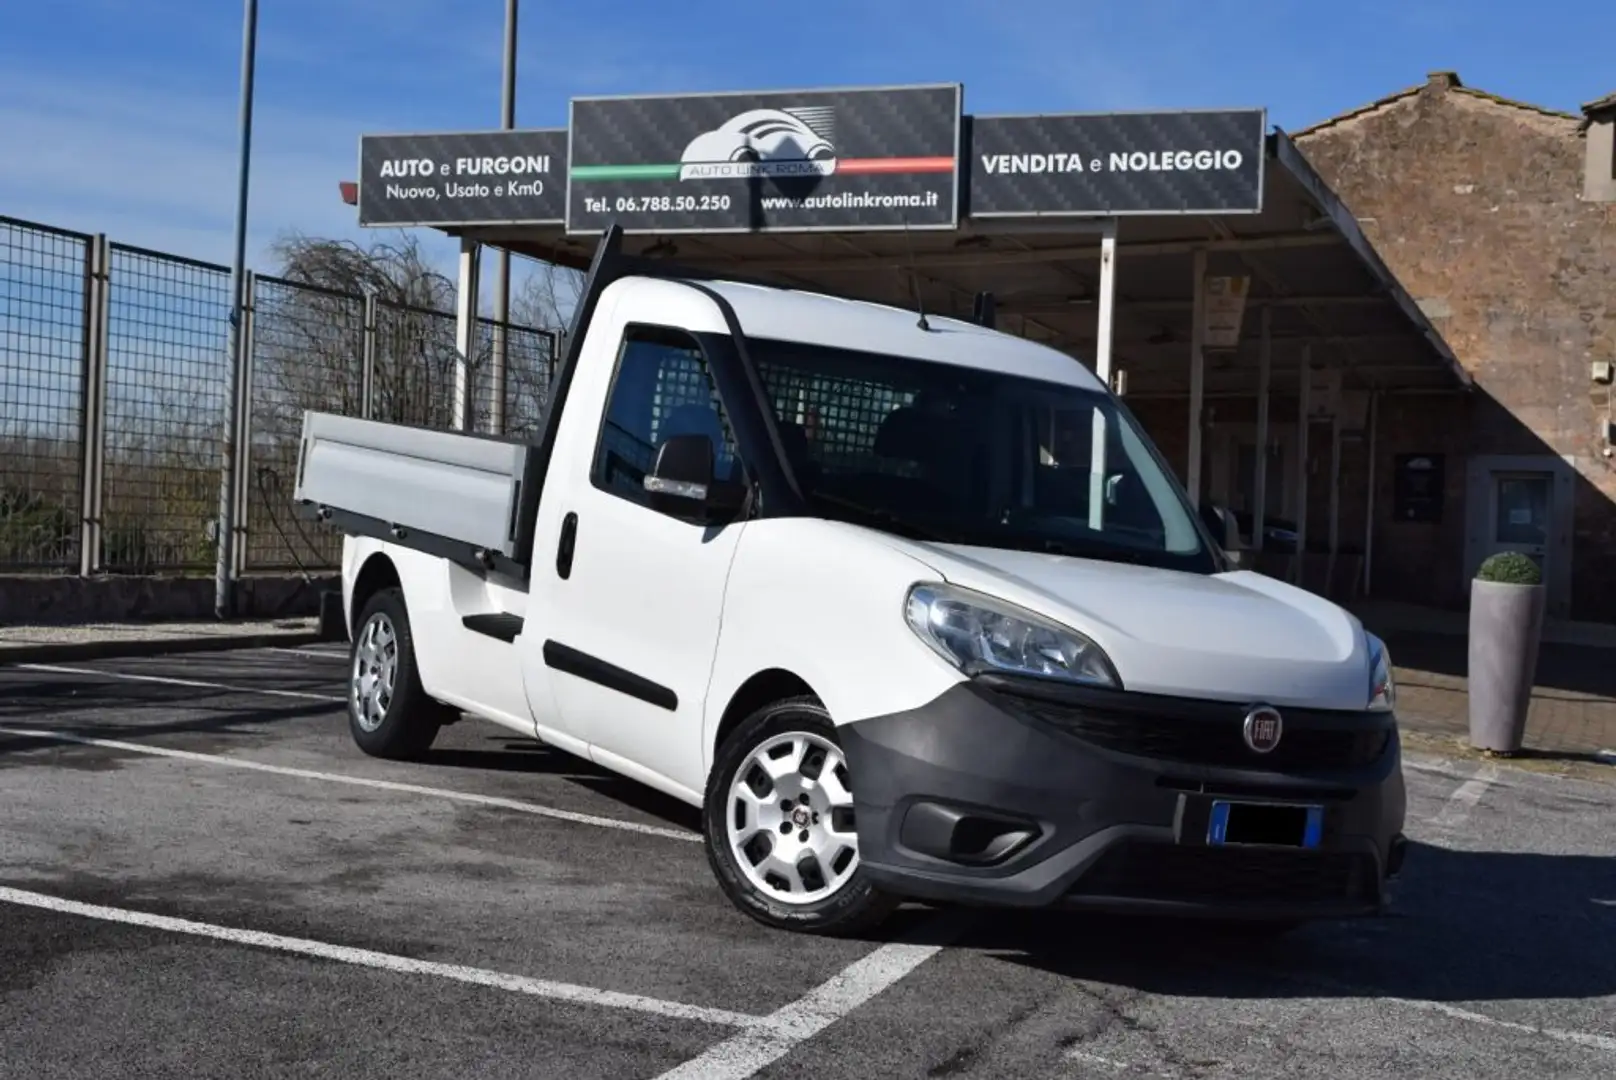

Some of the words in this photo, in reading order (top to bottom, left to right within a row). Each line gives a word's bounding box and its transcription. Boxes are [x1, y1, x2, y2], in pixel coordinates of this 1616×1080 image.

[380, 159, 434, 177] AUTO
[440, 163, 450, 176] e
[456, 155, 550, 175] FURGONI
[689, 165, 732, 176] AUTO
[736, 164, 770, 175] LINK
[776, 163, 825, 174] ROMA
[981, 153, 1084, 173] VENDITA
[1090, 158, 1102, 172] e
[1109, 150, 1243, 171] NOLEGGIO
[386, 183, 441, 200] Nuovo,
[445, 182, 490, 197] Usato
[494, 186, 503, 197] e
[507, 180, 543, 196] Km0
[760, 191, 939, 209] www.autolinkroma.it
[584, 198, 611, 213] Tel.
[615, 195, 731, 212] 06.788.50.250
[1253, 719, 1276, 741] FIAT
